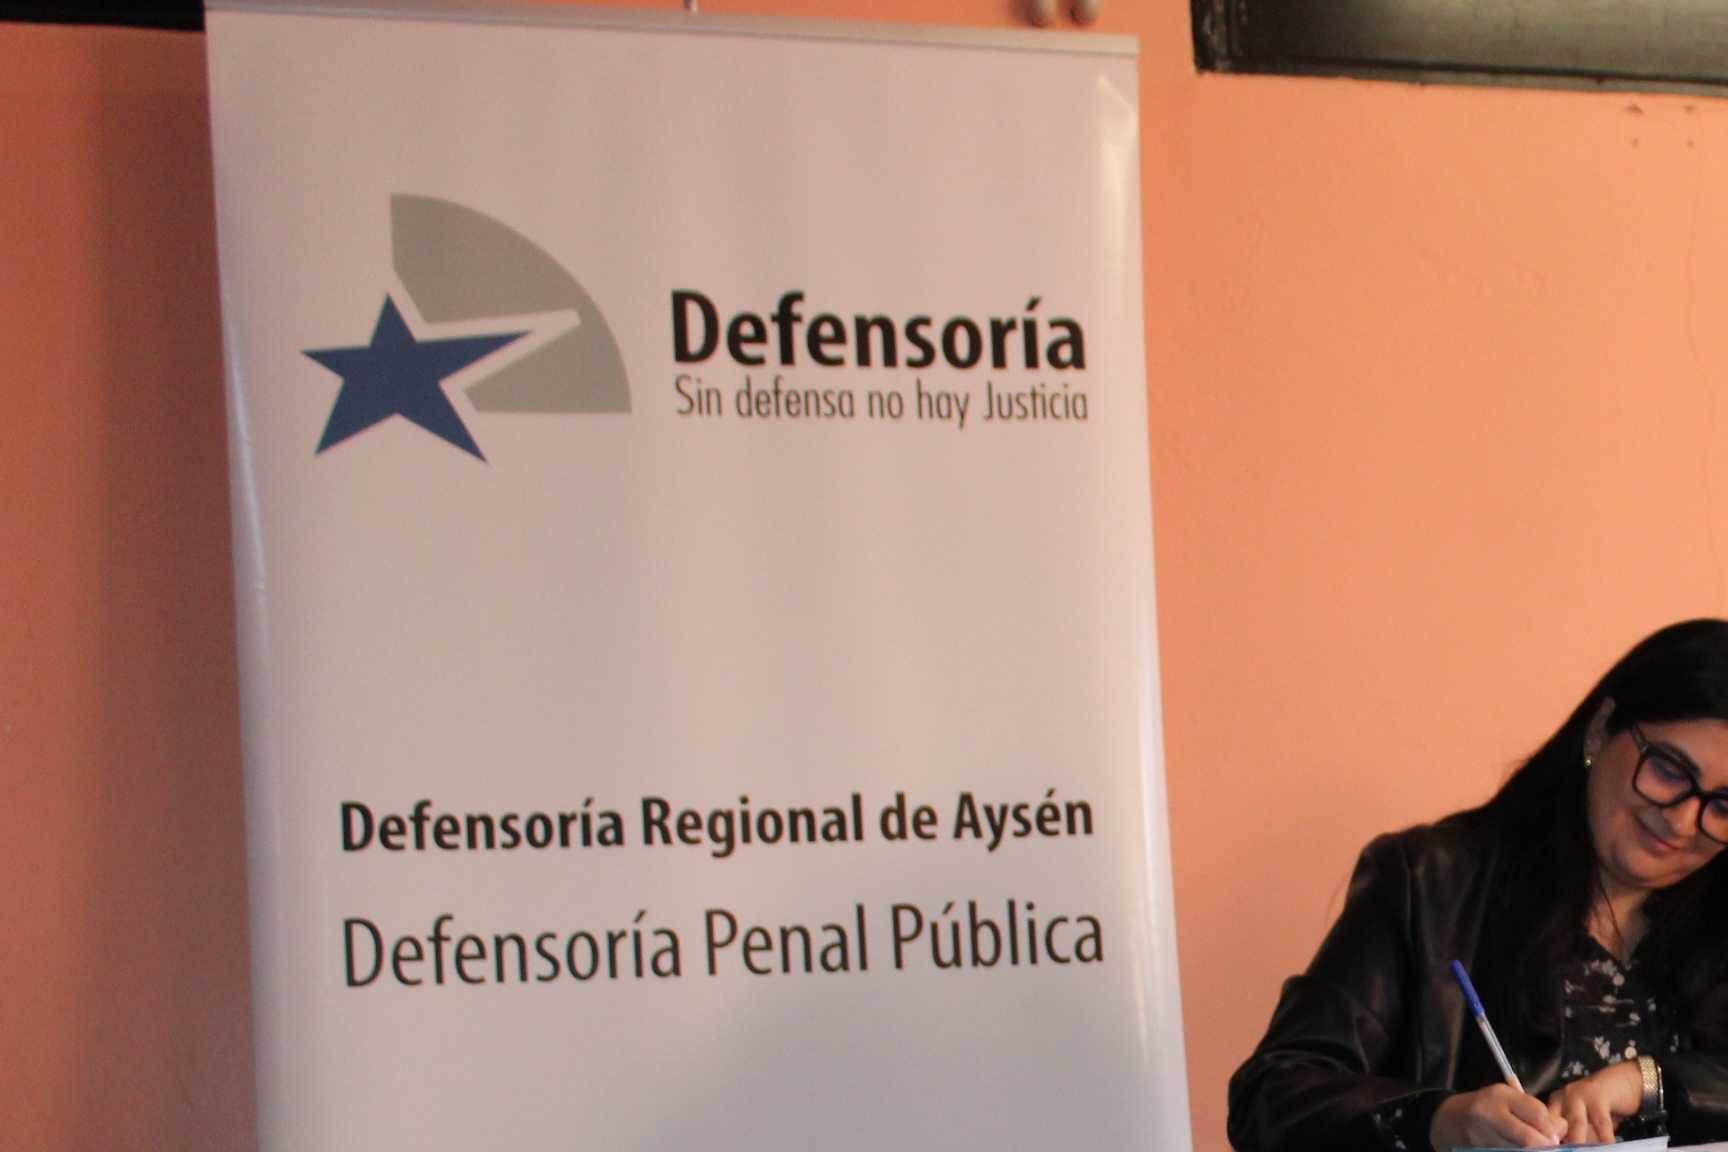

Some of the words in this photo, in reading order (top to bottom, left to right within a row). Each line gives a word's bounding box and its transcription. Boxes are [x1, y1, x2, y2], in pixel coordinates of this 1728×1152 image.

[671, 288, 1087, 372] Defensoría
[675, 374, 723, 417] Sin
[735, 375, 855, 418] defensa
[868, 391, 904, 419] no
[916, 378, 970, 429] hay
[983, 380, 1088, 421] Justicia
[340, 796, 625, 853] Defensoría
[640, 791, 865, 859] Regional
[879, 791, 939, 842] de
[952, 787, 1094, 854] Aysén
[343, 908, 682, 988] Defensoría
[704, 902, 869, 977] Penal
[890, 898, 1104, 972] Pública
